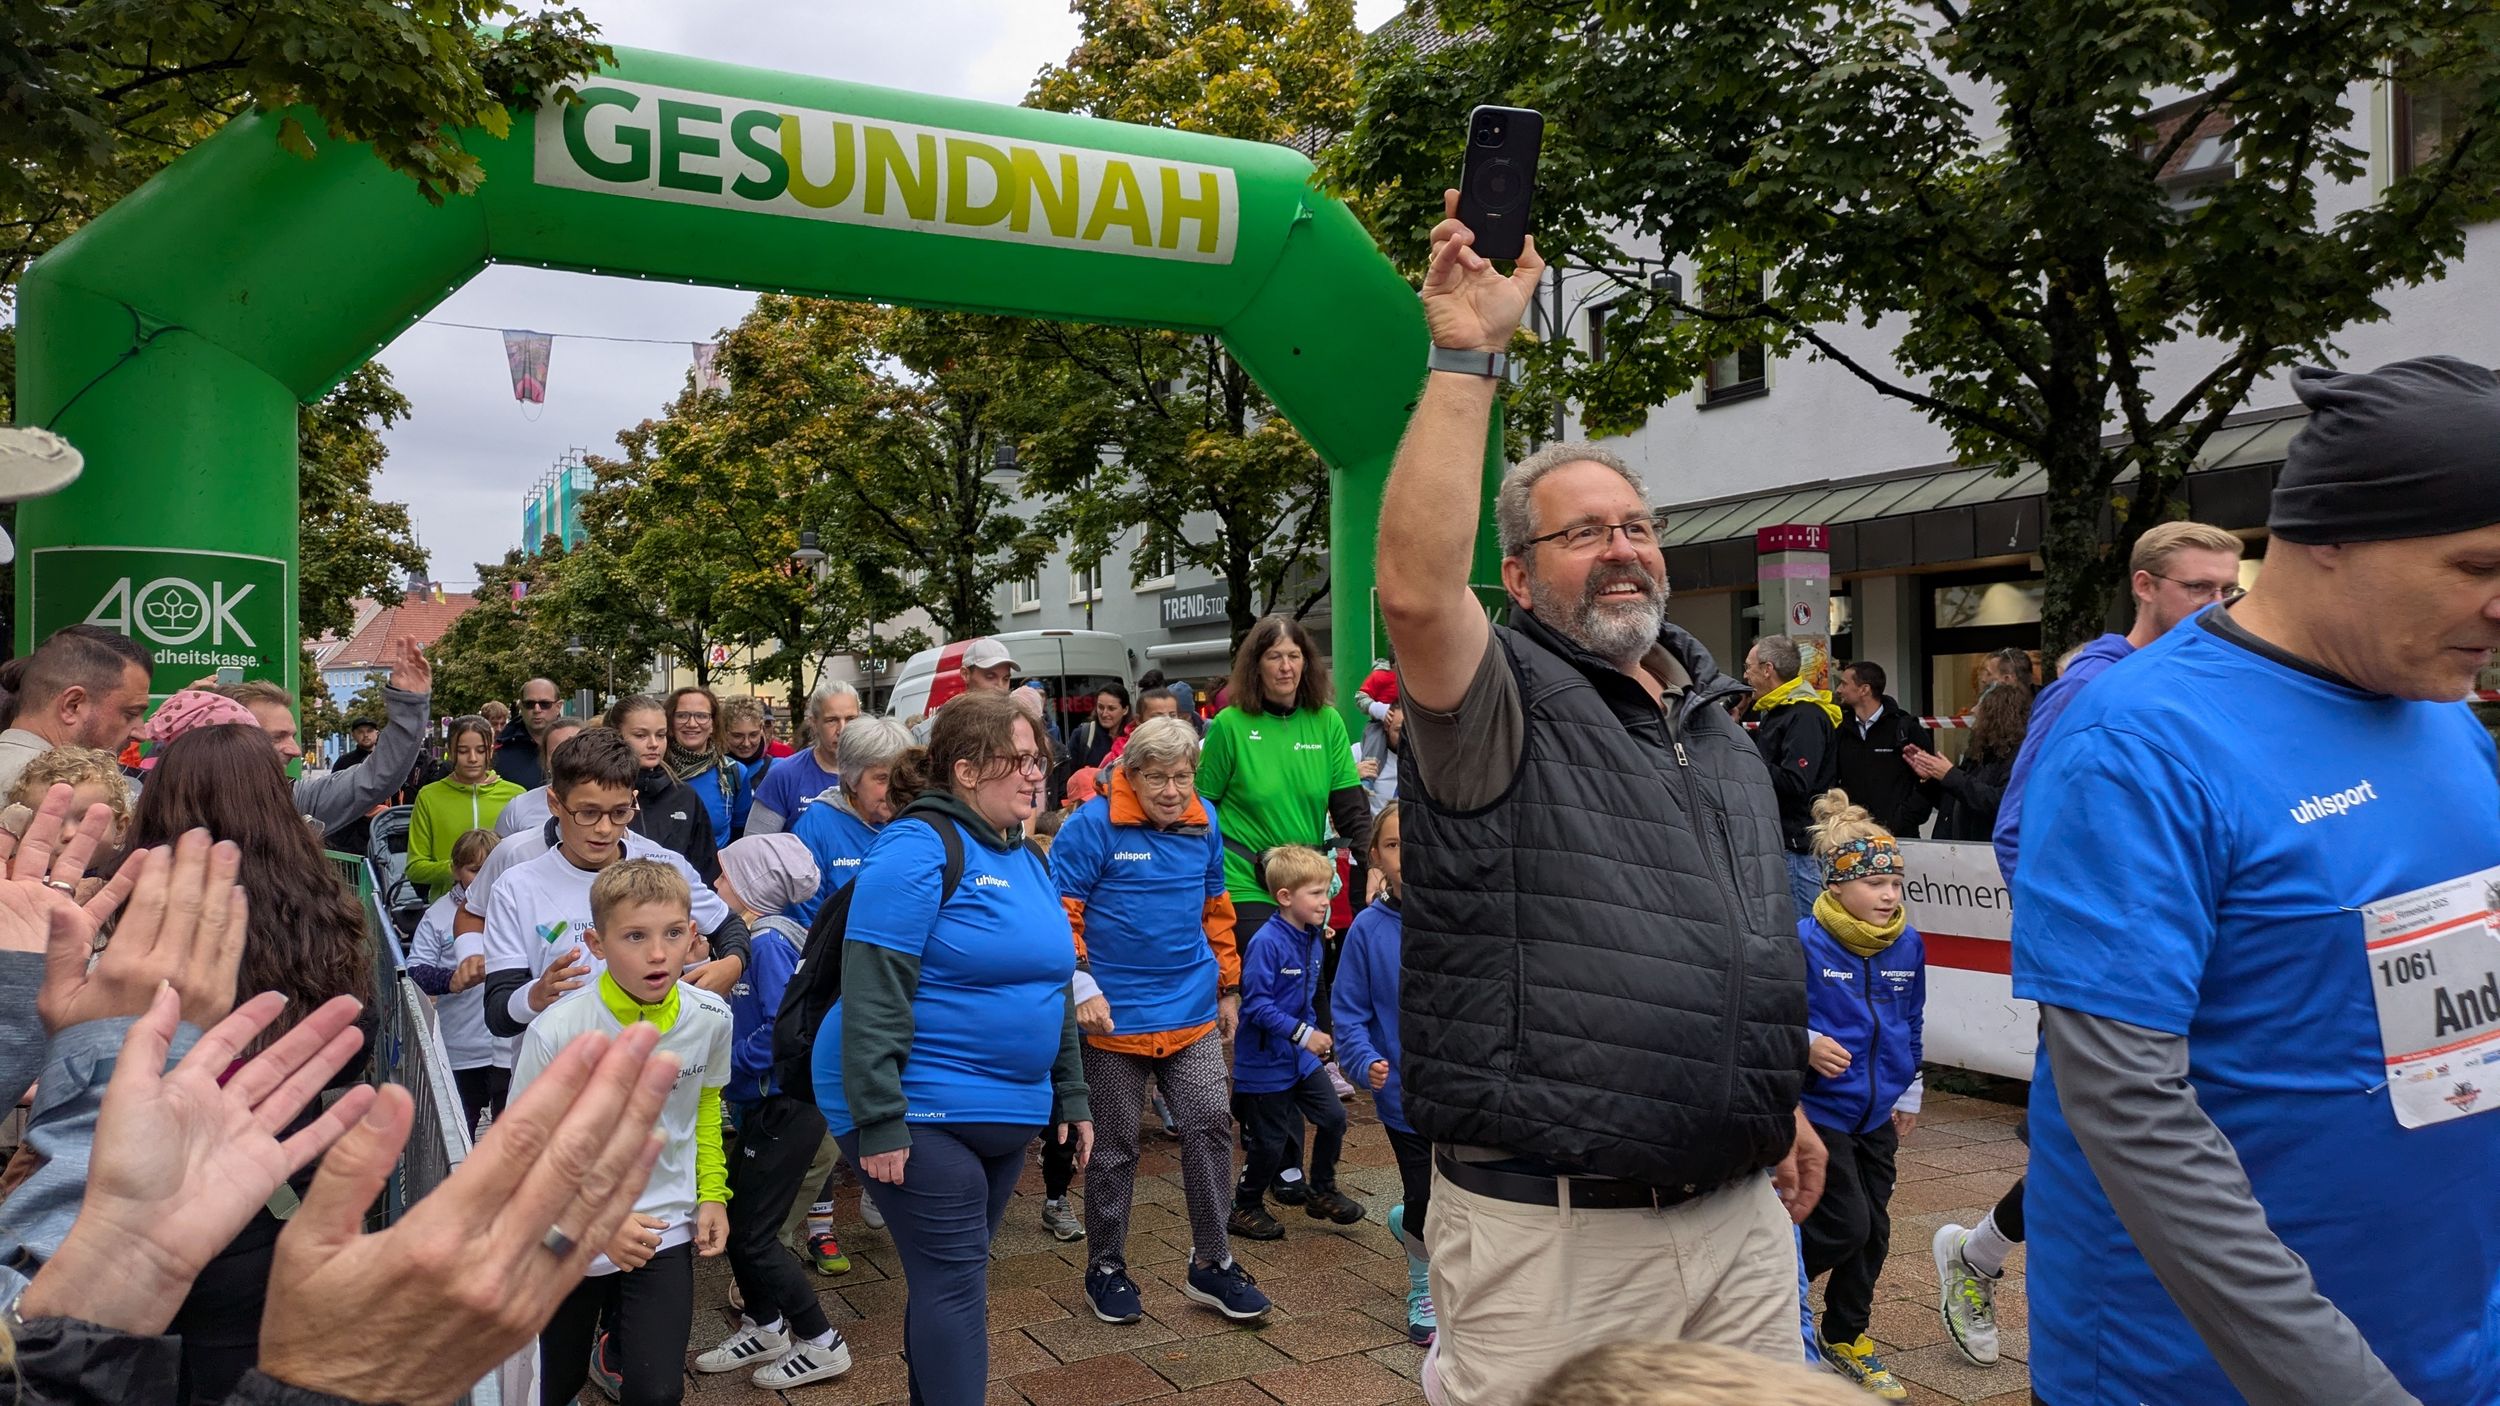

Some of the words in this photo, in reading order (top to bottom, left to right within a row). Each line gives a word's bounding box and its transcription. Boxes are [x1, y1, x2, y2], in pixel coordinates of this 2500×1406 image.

[562, 86, 1219, 255] GESUNDNAH
[1806, 527, 1820, 547] T
[82, 577, 257, 647] AOK
[154, 649, 260, 668] dheitskasse.
[2289, 779, 2378, 824] uhlsport
[833, 857, 861, 868] uhlspo
[1114, 851, 1151, 862] uhlsport
[976, 874, 1010, 888] uhlsport
[574, 921, 595, 931] UNS
[1823, 968, 1854, 981] Kempa
[2377, 948, 2438, 987] 1061
[699, 1002, 725, 1016] CRAFT
[677, 1063, 707, 1079] CHLÄGT
